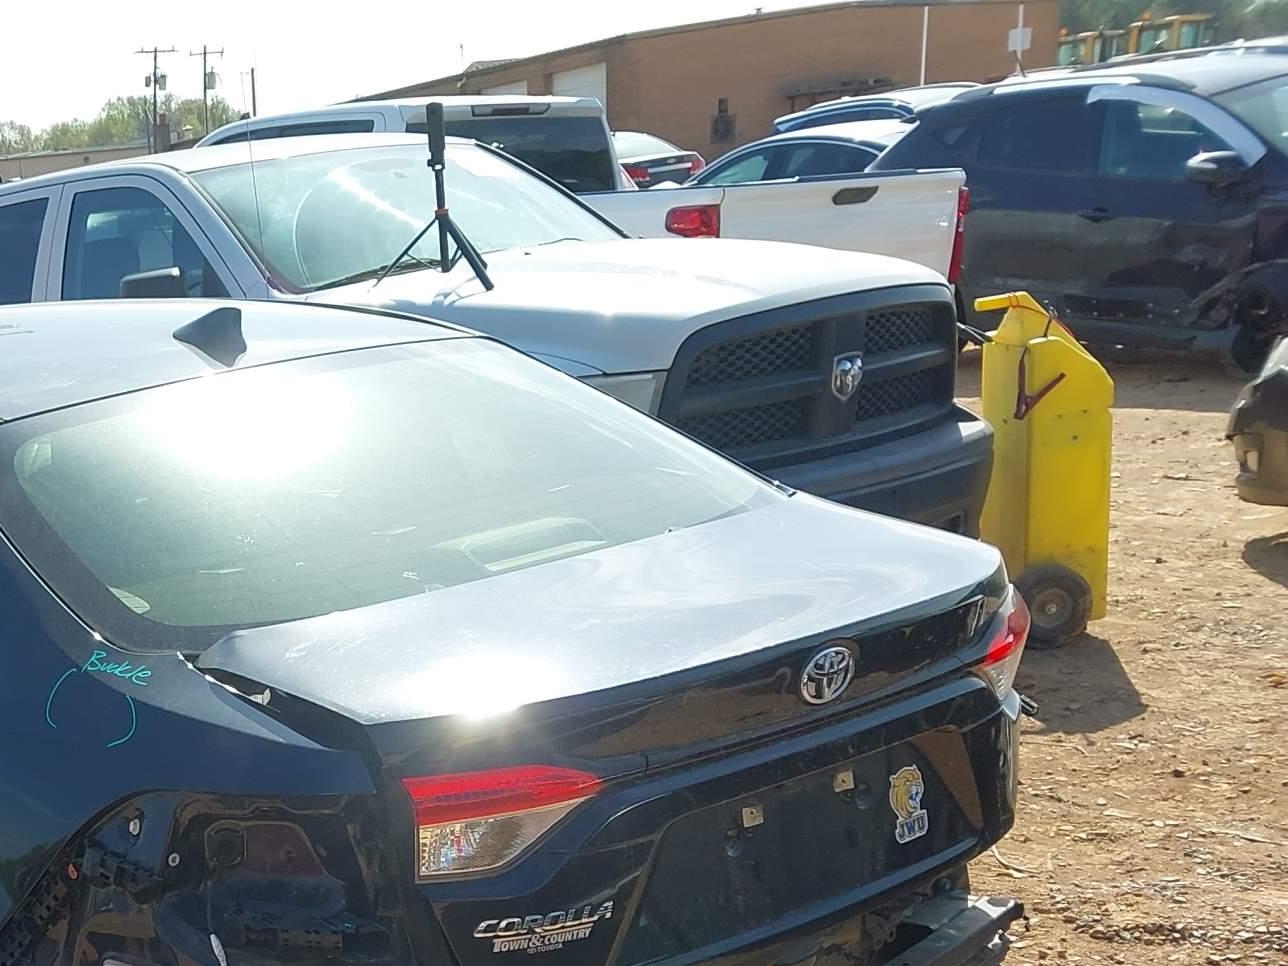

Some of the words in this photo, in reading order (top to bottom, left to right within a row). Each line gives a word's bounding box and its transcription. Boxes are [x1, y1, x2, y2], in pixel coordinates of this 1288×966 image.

[81, 650, 152, 686] Buckle
[898, 814, 926, 839] JWU
[472, 900, 614, 938] COROLLA
[537, 943, 563, 953] TOYOTA
